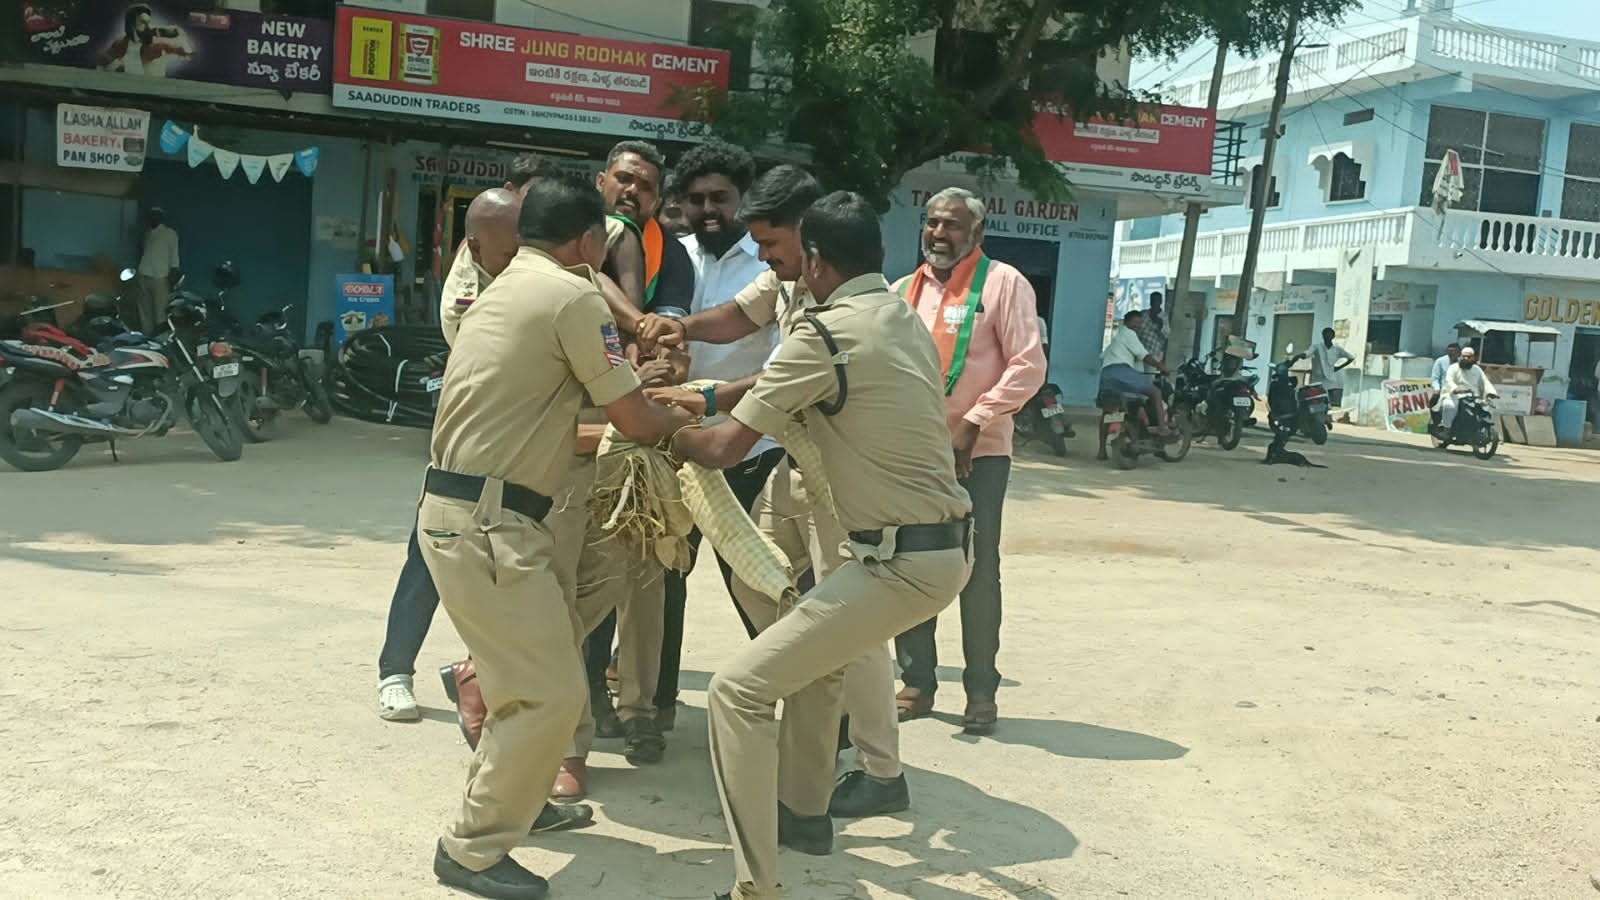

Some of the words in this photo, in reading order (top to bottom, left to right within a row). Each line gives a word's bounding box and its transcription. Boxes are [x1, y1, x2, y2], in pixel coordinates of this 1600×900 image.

[261, 21, 306, 38] NEW
[247, 39, 322, 61] BAKERY
[459, 31, 516, 53] SHREE
[521, 40, 569, 58] JUNG
[652, 53, 719, 75] CEMENT
[348, 90, 423, 108] SAADUDDIN
[426, 98, 481, 114] TRADERS
[1160, 113, 1208, 129] CEMENT
[64, 132, 117, 148] BAKERY
[64, 150, 86, 162] PAN
[90, 151, 120, 165] SHOP
[415, 156, 507, 178] SADUDDI
[1014, 200, 1079, 222] GARDEN
[1016, 222, 1059, 237] OFFICE
